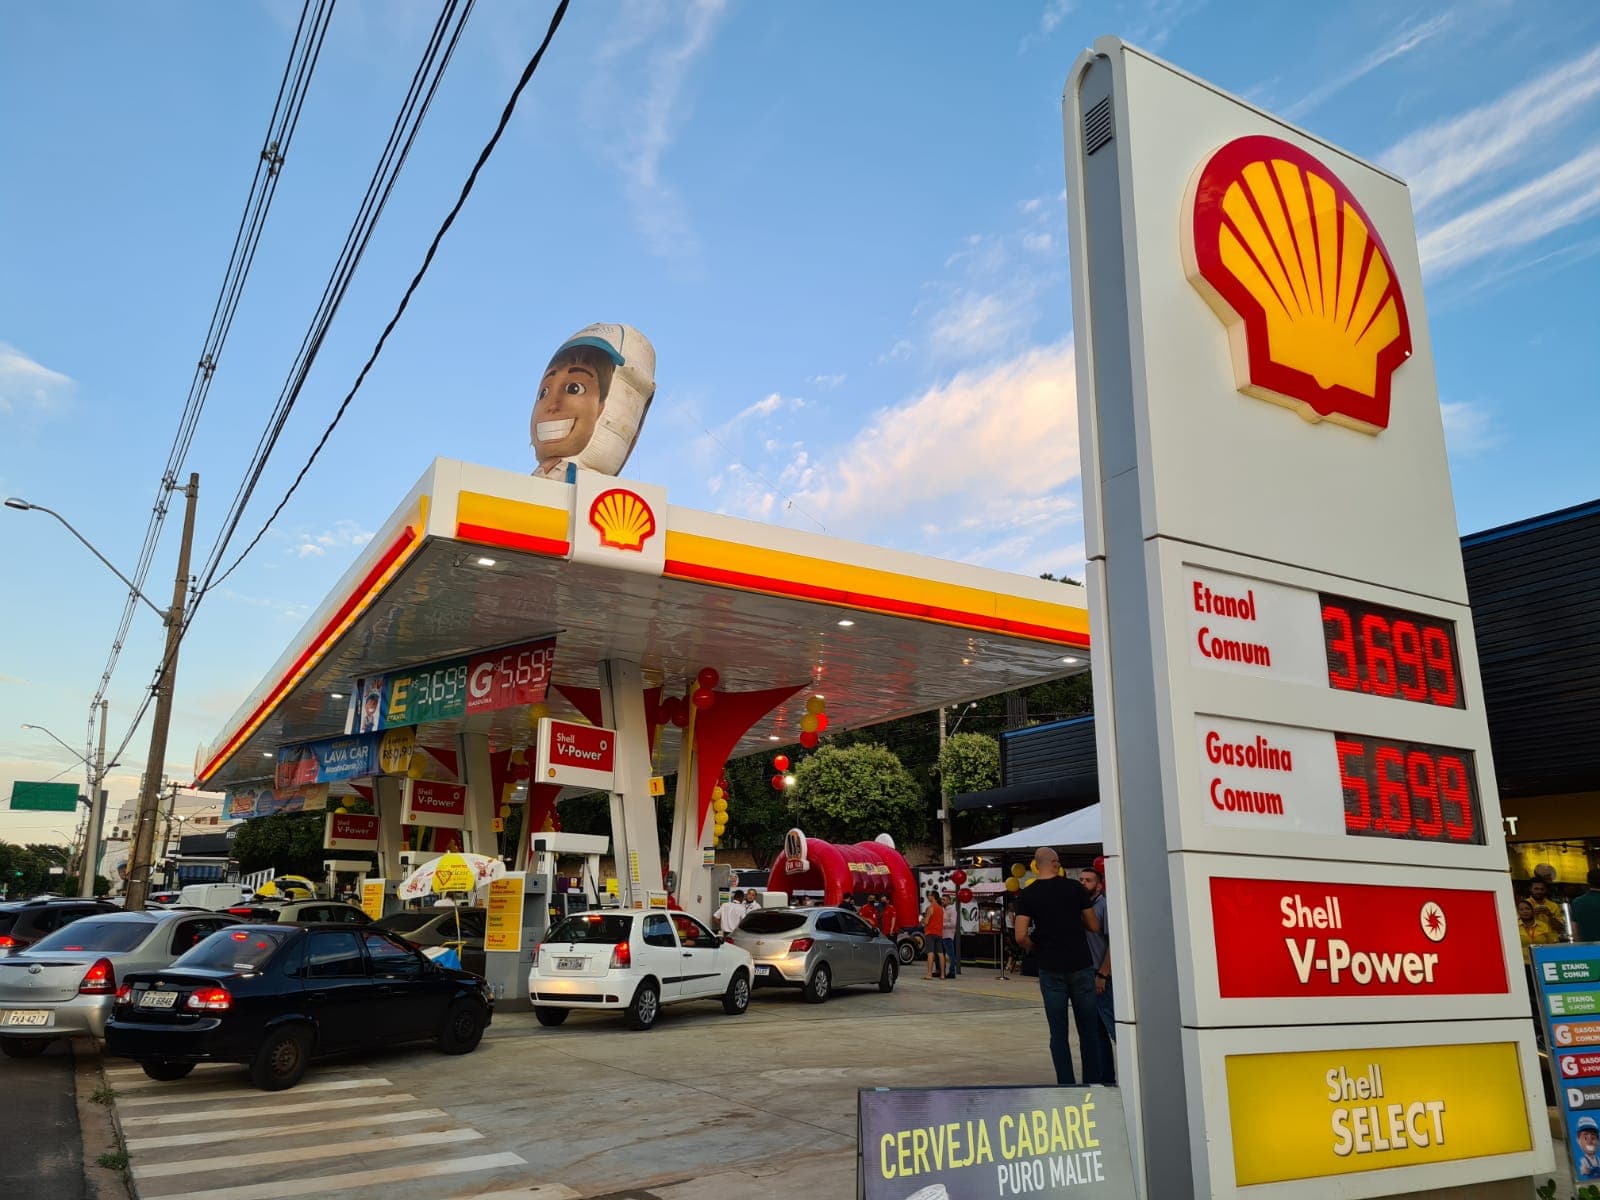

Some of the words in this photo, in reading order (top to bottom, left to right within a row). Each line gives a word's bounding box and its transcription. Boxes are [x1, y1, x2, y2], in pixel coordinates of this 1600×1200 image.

[1193, 581, 1256, 621] Etanol
[1198, 627, 1271, 667] Comum
[1321, 605, 1458, 706] 3.699
[469, 662, 494, 698] G
[389, 677, 412, 715] E
[556, 732, 575, 744] Shell
[557, 743, 602, 760] V-Power
[1206, 731, 1292, 772] Gasolina
[324, 749, 347, 764] LAVA
[349, 745, 369, 760] CAR
[417, 787, 433, 796] Shell
[418, 795, 456, 808] V-Power
[1210, 777, 1284, 816] Comum
[1336, 740, 1474, 838] 5.699
[337, 819, 351, 827] Shell
[337, 826, 370, 835] V-Power
[1280, 894, 1342, 929] Shell
[1285, 938, 1439, 985] V-Power
[1543, 962, 1559, 981] E
[1563, 971, 1590, 979] COMUM
[1549, 994, 1565, 1014] E
[1567, 995, 1595, 1003] ETANOL
[1556, 1025, 1572, 1044] G
[1562, 1056, 1579, 1076] G
[1326, 1063, 1384, 1103] Shell
[1567, 1088, 1585, 1108] D
[880, 1118, 994, 1180] CERVEJA
[999, 1093, 1100, 1160] CABARÉ
[1331, 1100, 1445, 1157] SELECT
[997, 1158, 1045, 1196] PURO
[1049, 1151, 1105, 1188] MALTE
